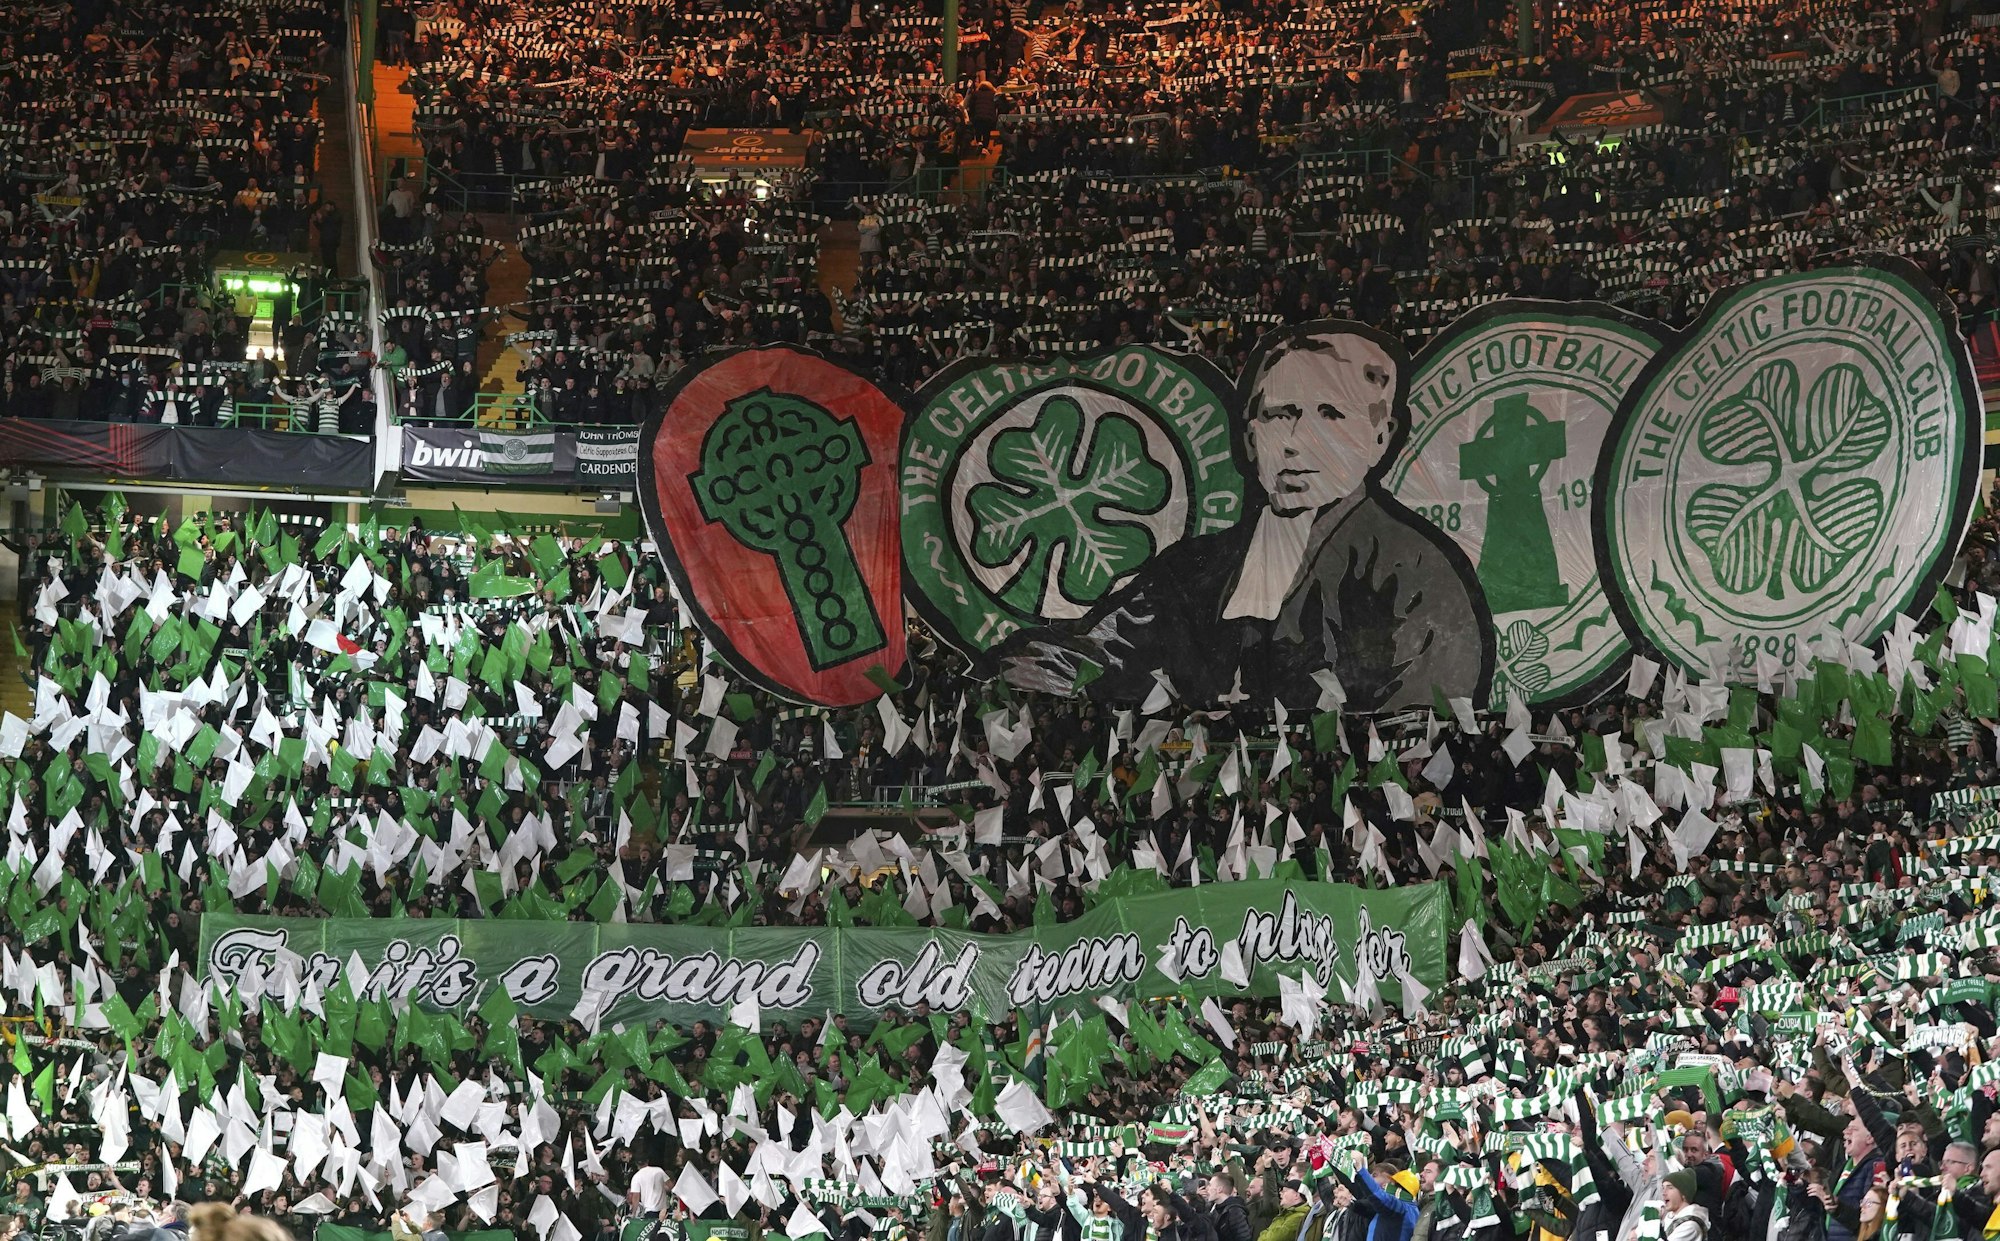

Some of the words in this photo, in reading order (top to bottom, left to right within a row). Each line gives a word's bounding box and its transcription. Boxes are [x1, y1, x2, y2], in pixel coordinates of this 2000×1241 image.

[1577, 104, 1654, 117] adidas
[1207, 181, 1224, 189] CELTIC
[1467, 334, 1638, 394] FOOTBALL
[1633, 407, 1684, 482] THE
[1674, 304, 1774, 400] CELTIC
[1783, 289, 1920, 372] FOOTBALL
[1907, 361, 1942, 461] CLUB
[580, 431, 604, 440] JOHN
[580, 446, 594, 456] Celtic
[580, 462, 636, 474] CARDENDE
[903, 438, 948, 515] THE
[365, 933, 478, 1008] it's
[500, 952, 561, 1005] a
[582, 939, 822, 1018] grand
[856, 938, 980, 1012] old
[1005, 932, 1147, 1008] team
[1164, 914, 1218, 981] to
[1234, 888, 1339, 990] play
[1353, 904, 1412, 996] for
[46, 1164, 79, 1172] NORTH
[867, 1197, 885, 1206] CELTIC
[886, 1196, 894, 1205] FC
[730, 1229, 748, 1237] CURVE
